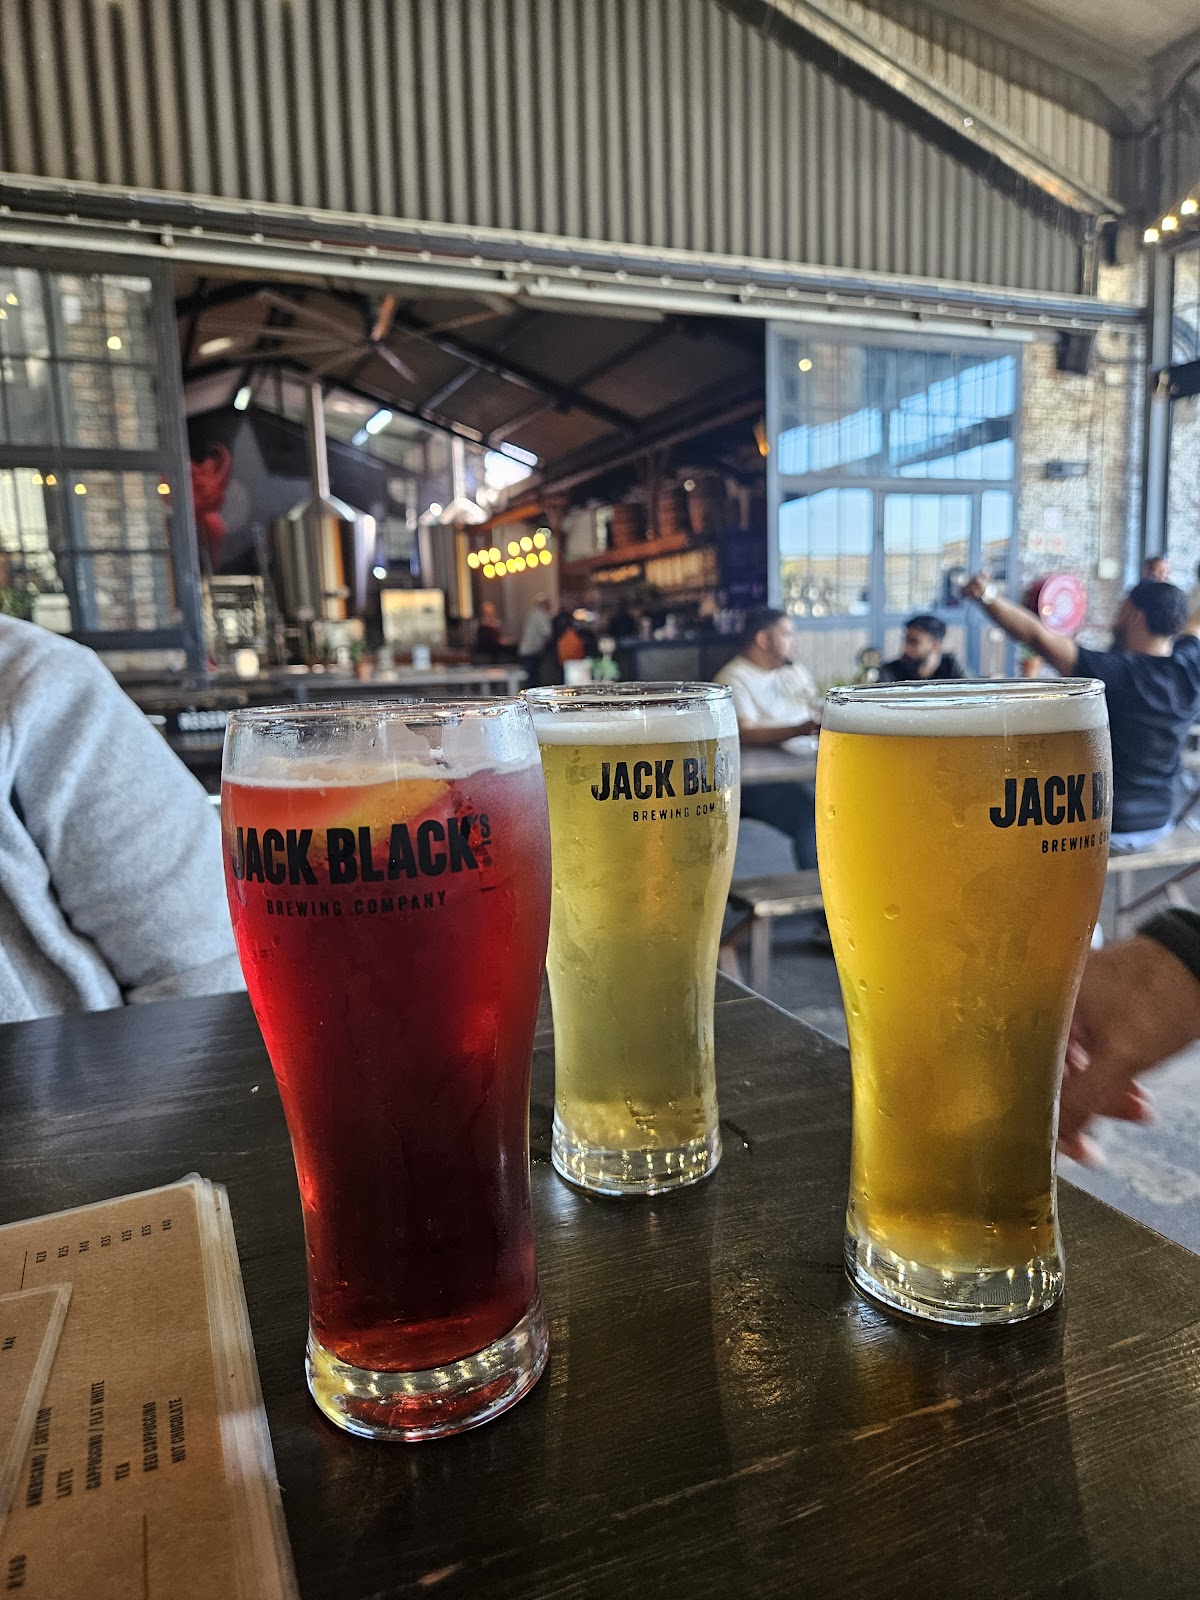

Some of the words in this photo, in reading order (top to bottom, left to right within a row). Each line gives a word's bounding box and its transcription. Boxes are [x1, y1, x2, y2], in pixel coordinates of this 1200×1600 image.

[591, 760, 676, 801] JACK
[633, 806, 690, 822] BREWING
[696, 803, 716, 816] COM
[990, 774, 1087, 828] JACK
[1092, 771, 1107, 820] B
[232, 826, 319, 886] JACK
[1041, 833, 1095, 854] BREWING
[266, 898, 343, 917] BREWING
[353, 889, 447, 915] COMPANY
[162, 1219, 172, 1231] R40
[58, 1245, 69, 1258] R25
[79, 1240, 90, 1253] R40
[91, 1380, 105, 1406] WHITE
[34, 1407, 52, 1446] CORTADO
[89, 1406, 104, 1427] FLAT
[142, 1401, 158, 1453] CAPPUCCINO
[169, 1397, 185, 1445] CHOCOLATE
[85, 1433, 104, 1491] CAPPUCCINO
[143, 1452, 159, 1473] RED
[171, 1445, 187, 1464] HOT
[26, 1453, 48, 1508] AMERICANO
[56, 1467, 74, 1499] LATTE
[114, 1461, 131, 1482] TEA
